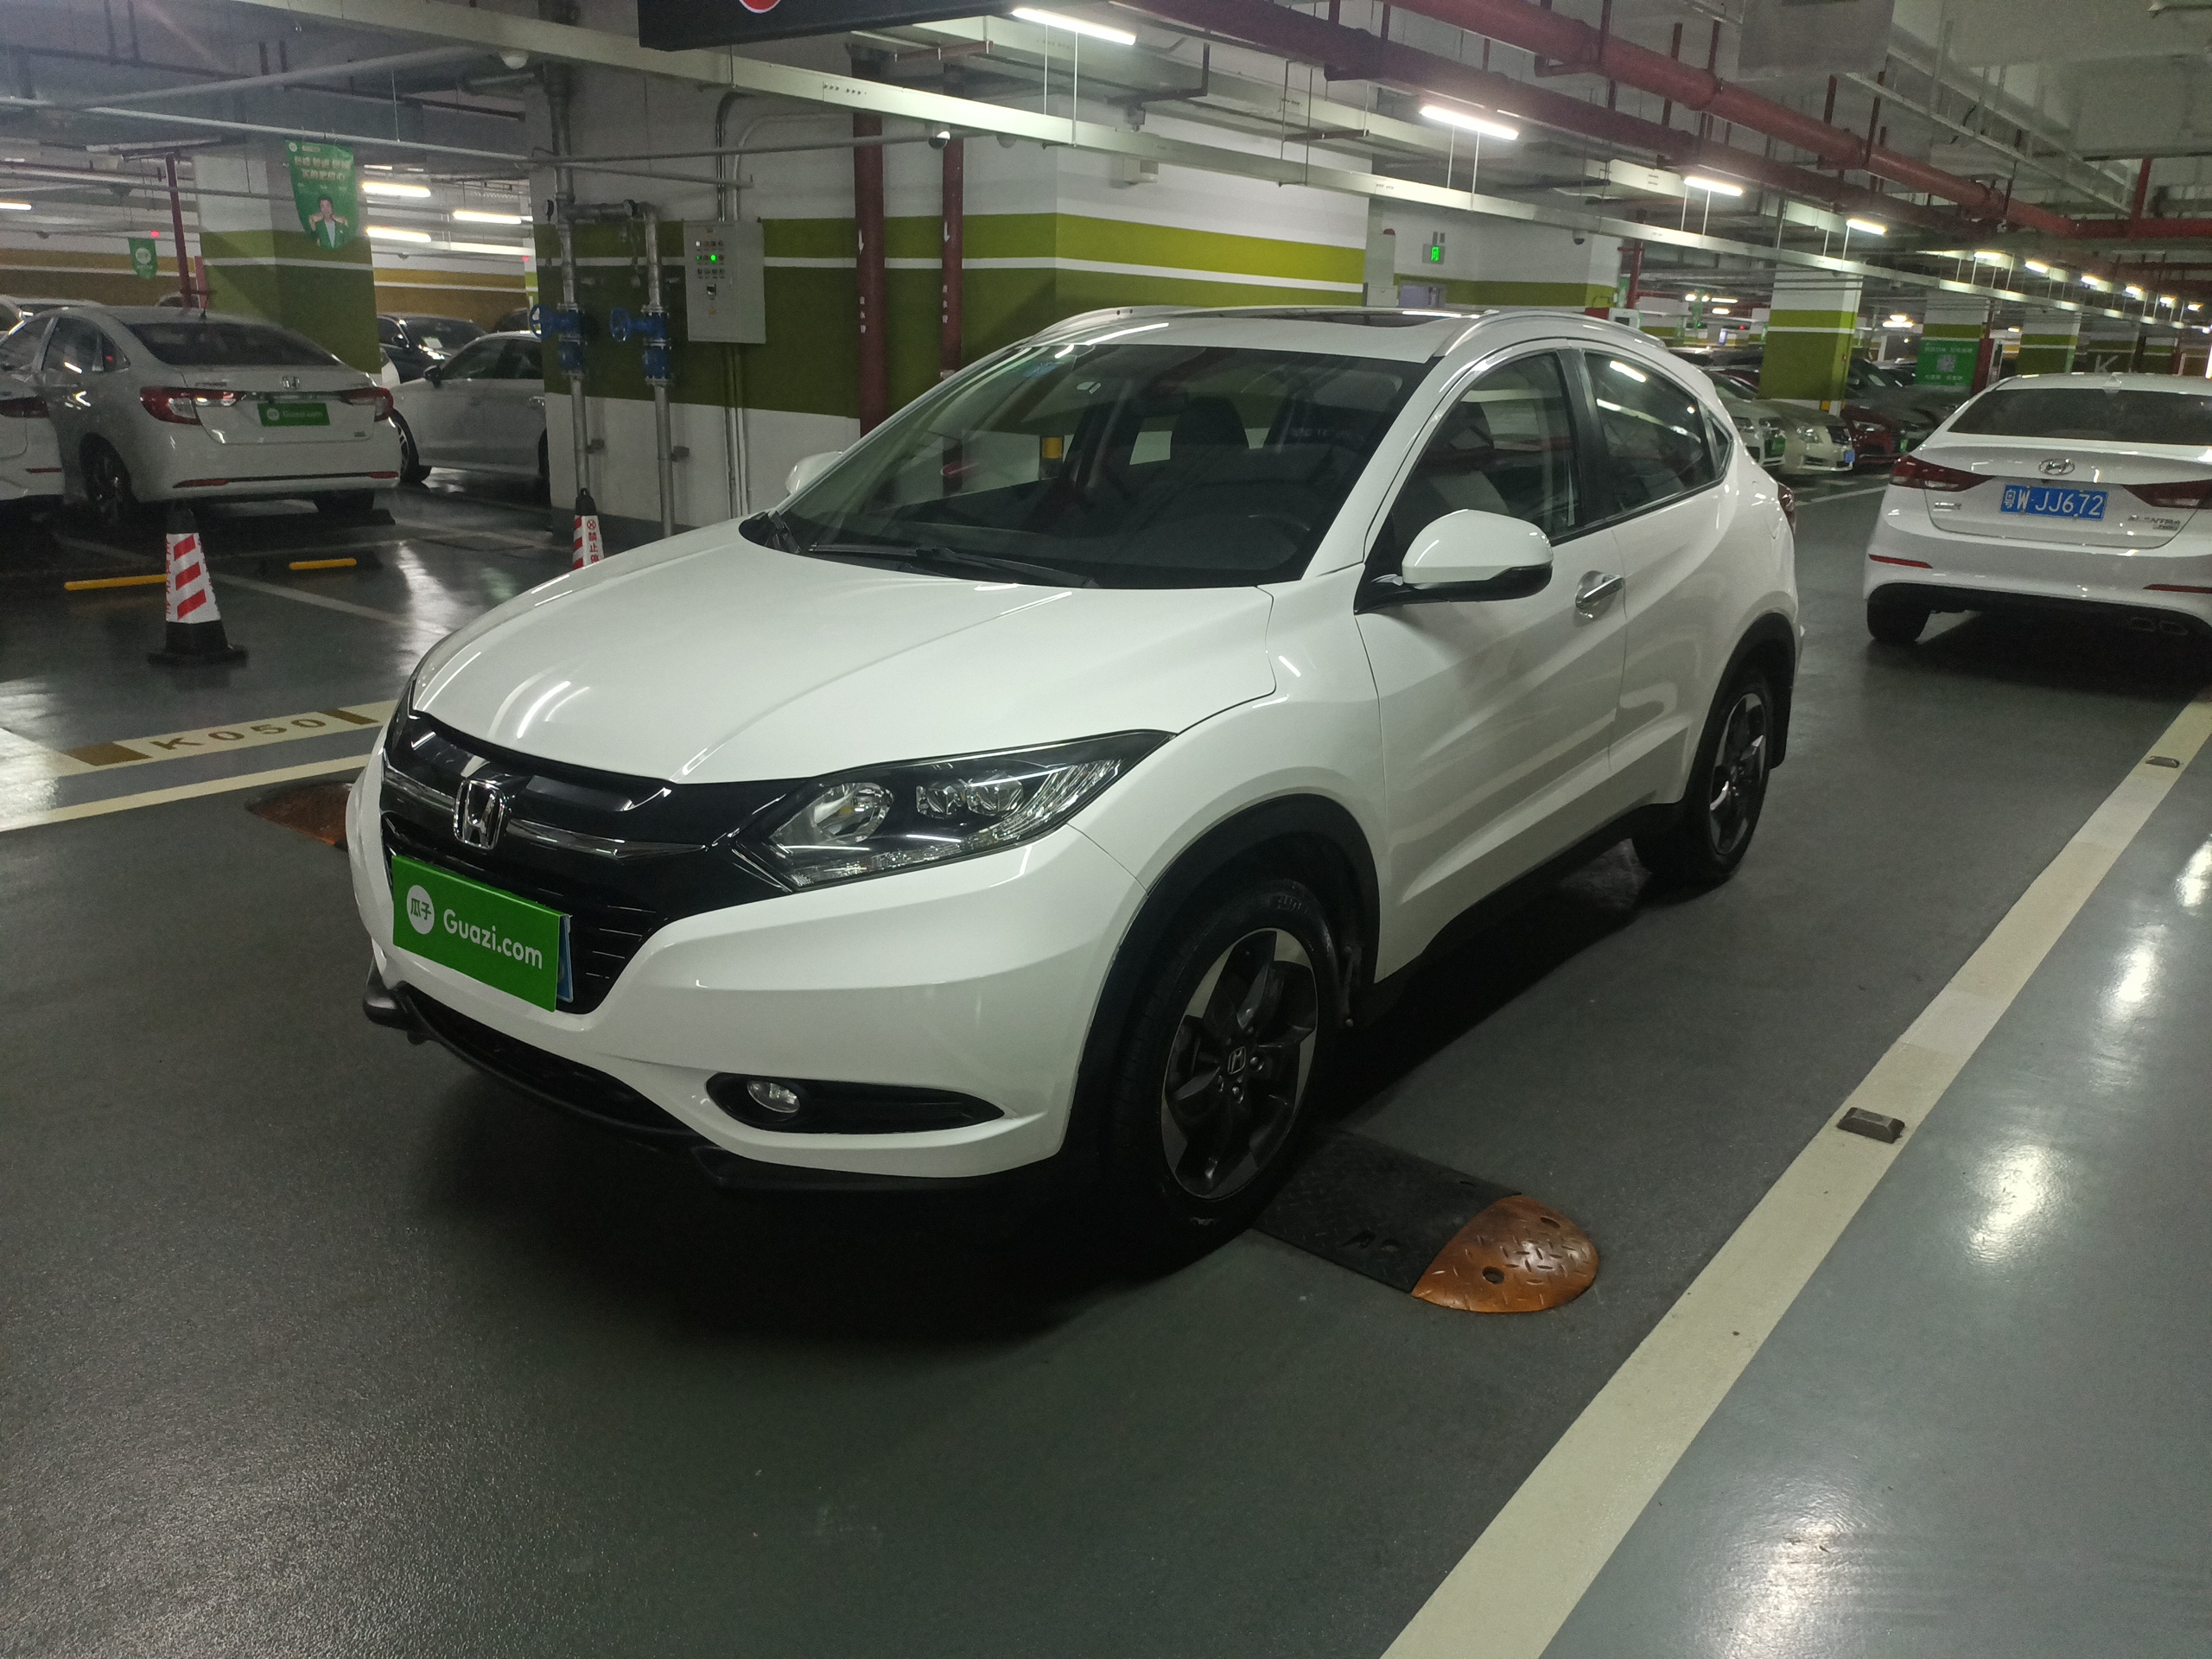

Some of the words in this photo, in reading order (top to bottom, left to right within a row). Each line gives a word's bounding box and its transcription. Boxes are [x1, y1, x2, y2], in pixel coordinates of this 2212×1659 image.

[149, 718, 327, 750] K050
[410, 897, 432, 921] 瓜子
[443, 908, 543, 969] Guazi.com
